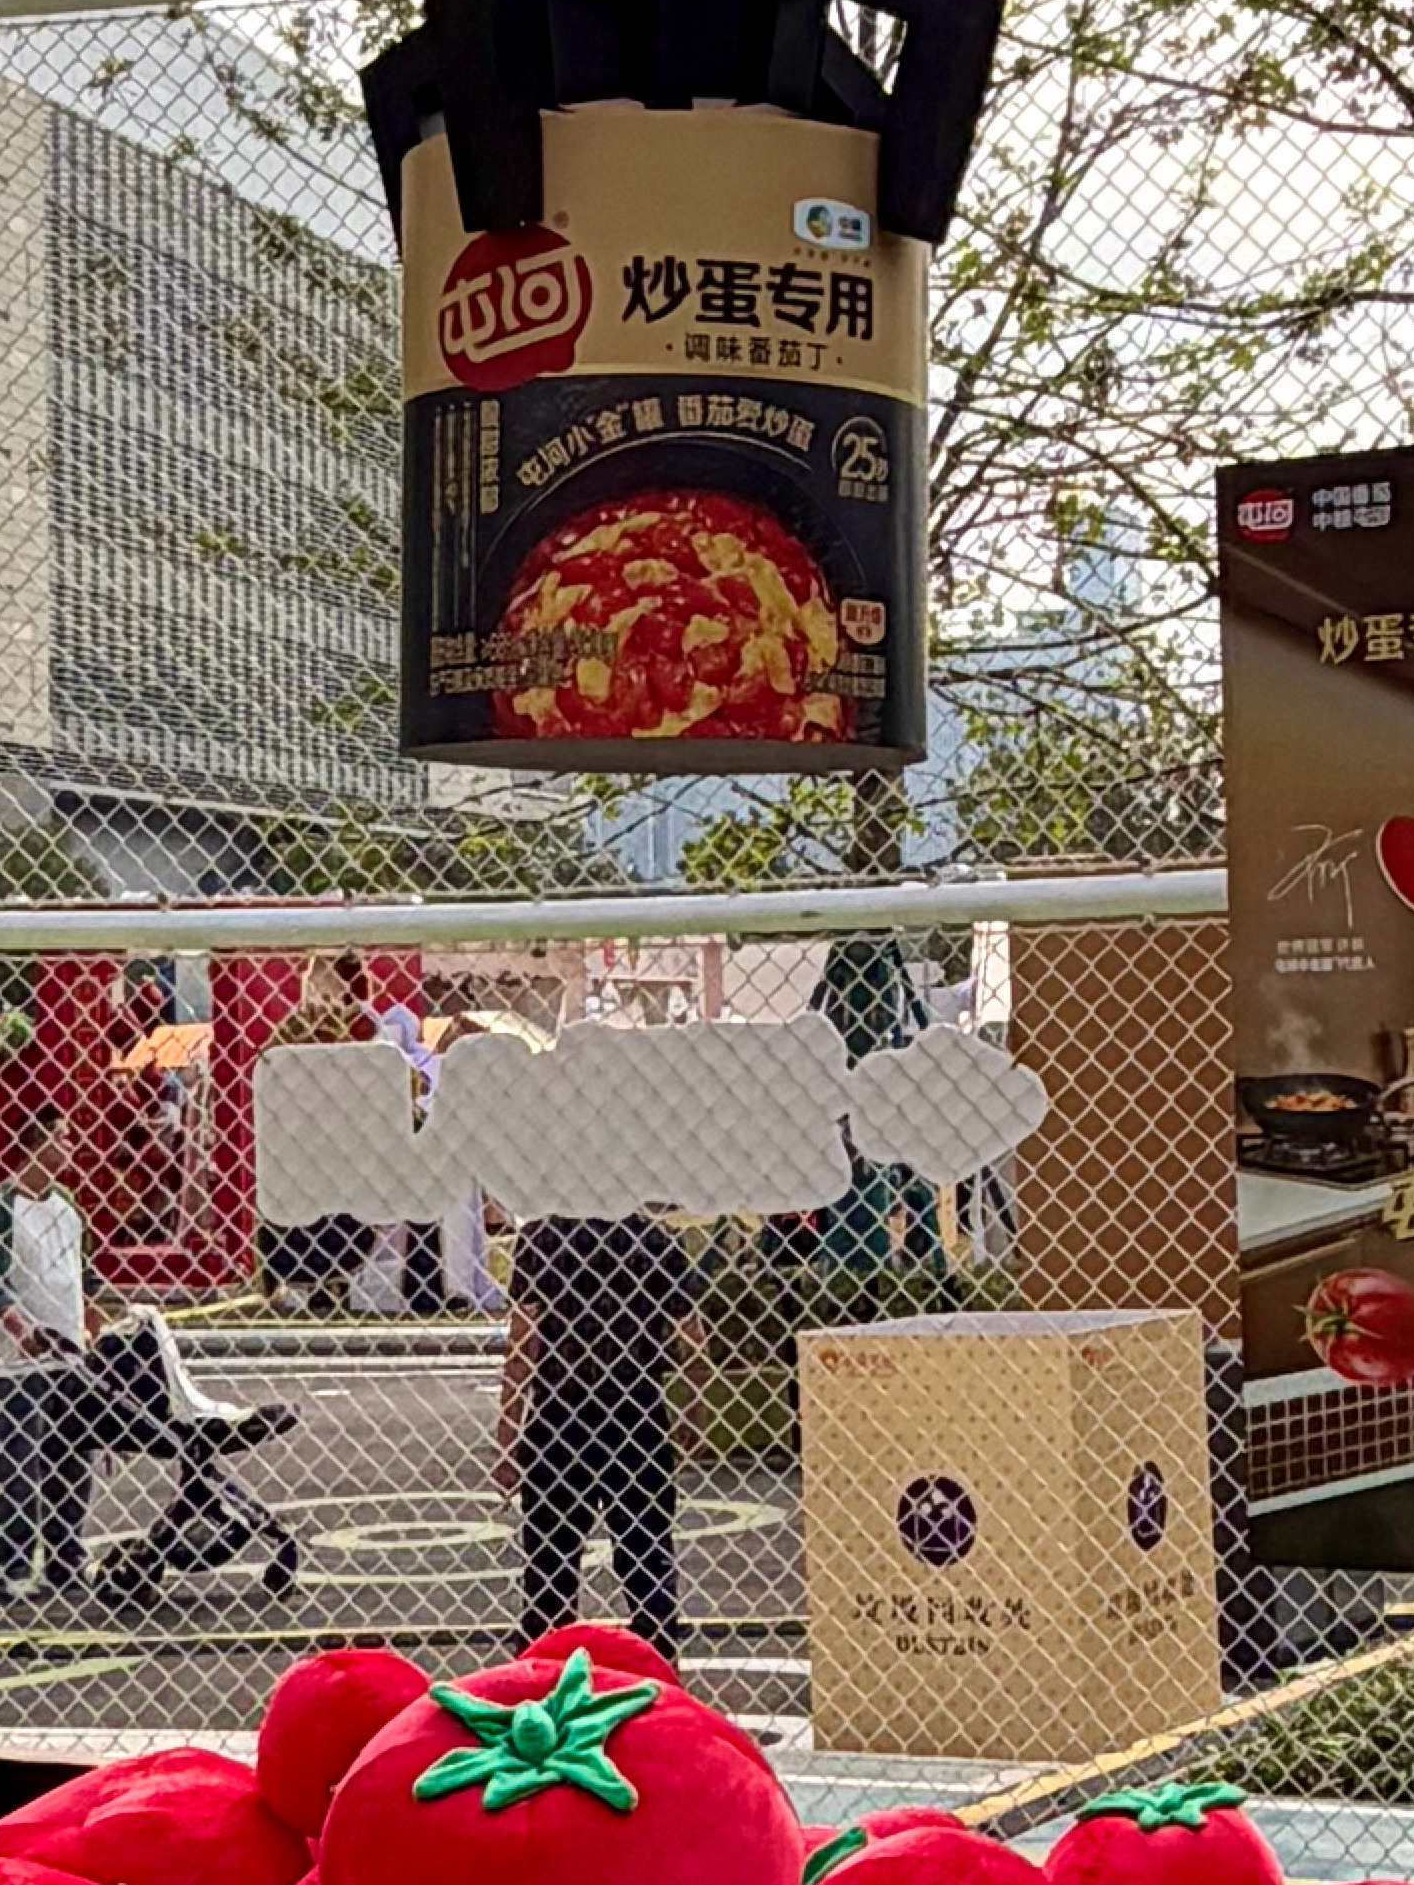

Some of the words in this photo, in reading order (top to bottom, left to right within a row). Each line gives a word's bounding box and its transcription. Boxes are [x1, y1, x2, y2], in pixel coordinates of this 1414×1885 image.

[438, 245, 581, 363] 屯河
[621, 254, 874, 341] 炒蛋专用
[683, 332, 830, 370] 调味番茄丁
